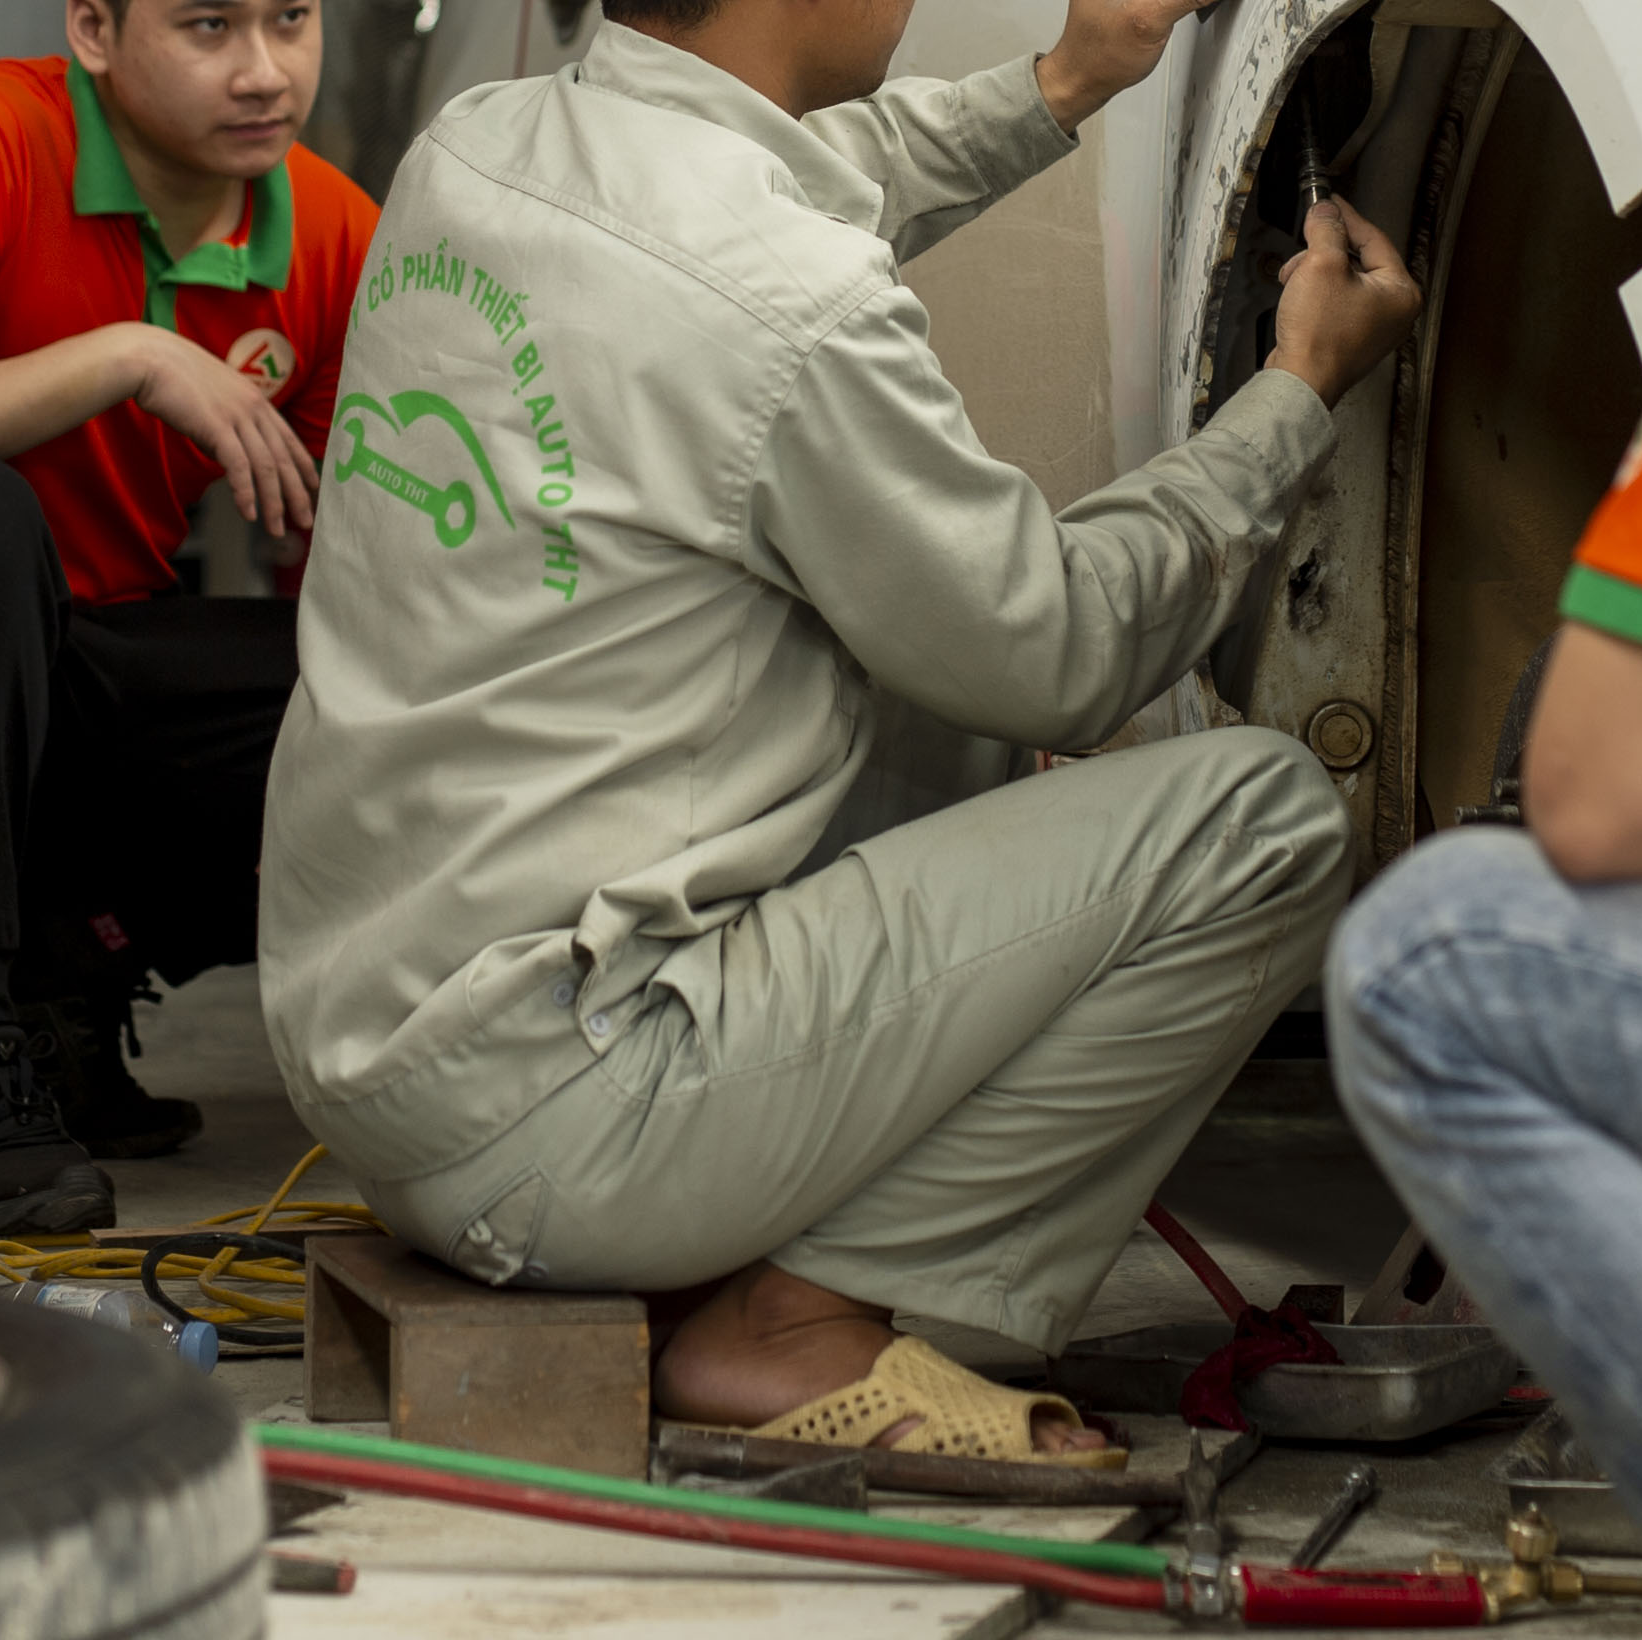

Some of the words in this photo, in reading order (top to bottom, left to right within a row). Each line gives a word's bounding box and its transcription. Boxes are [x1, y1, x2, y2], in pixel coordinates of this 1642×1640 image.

[468, 266, 530, 347] THIẾT
[511, 340, 545, 396] BỊ
[367, 460, 402, 490] AUTO
[404, 480, 430, 505] THT
[523, 393, 576, 509] AUTO
[541, 522, 581, 603] THT
